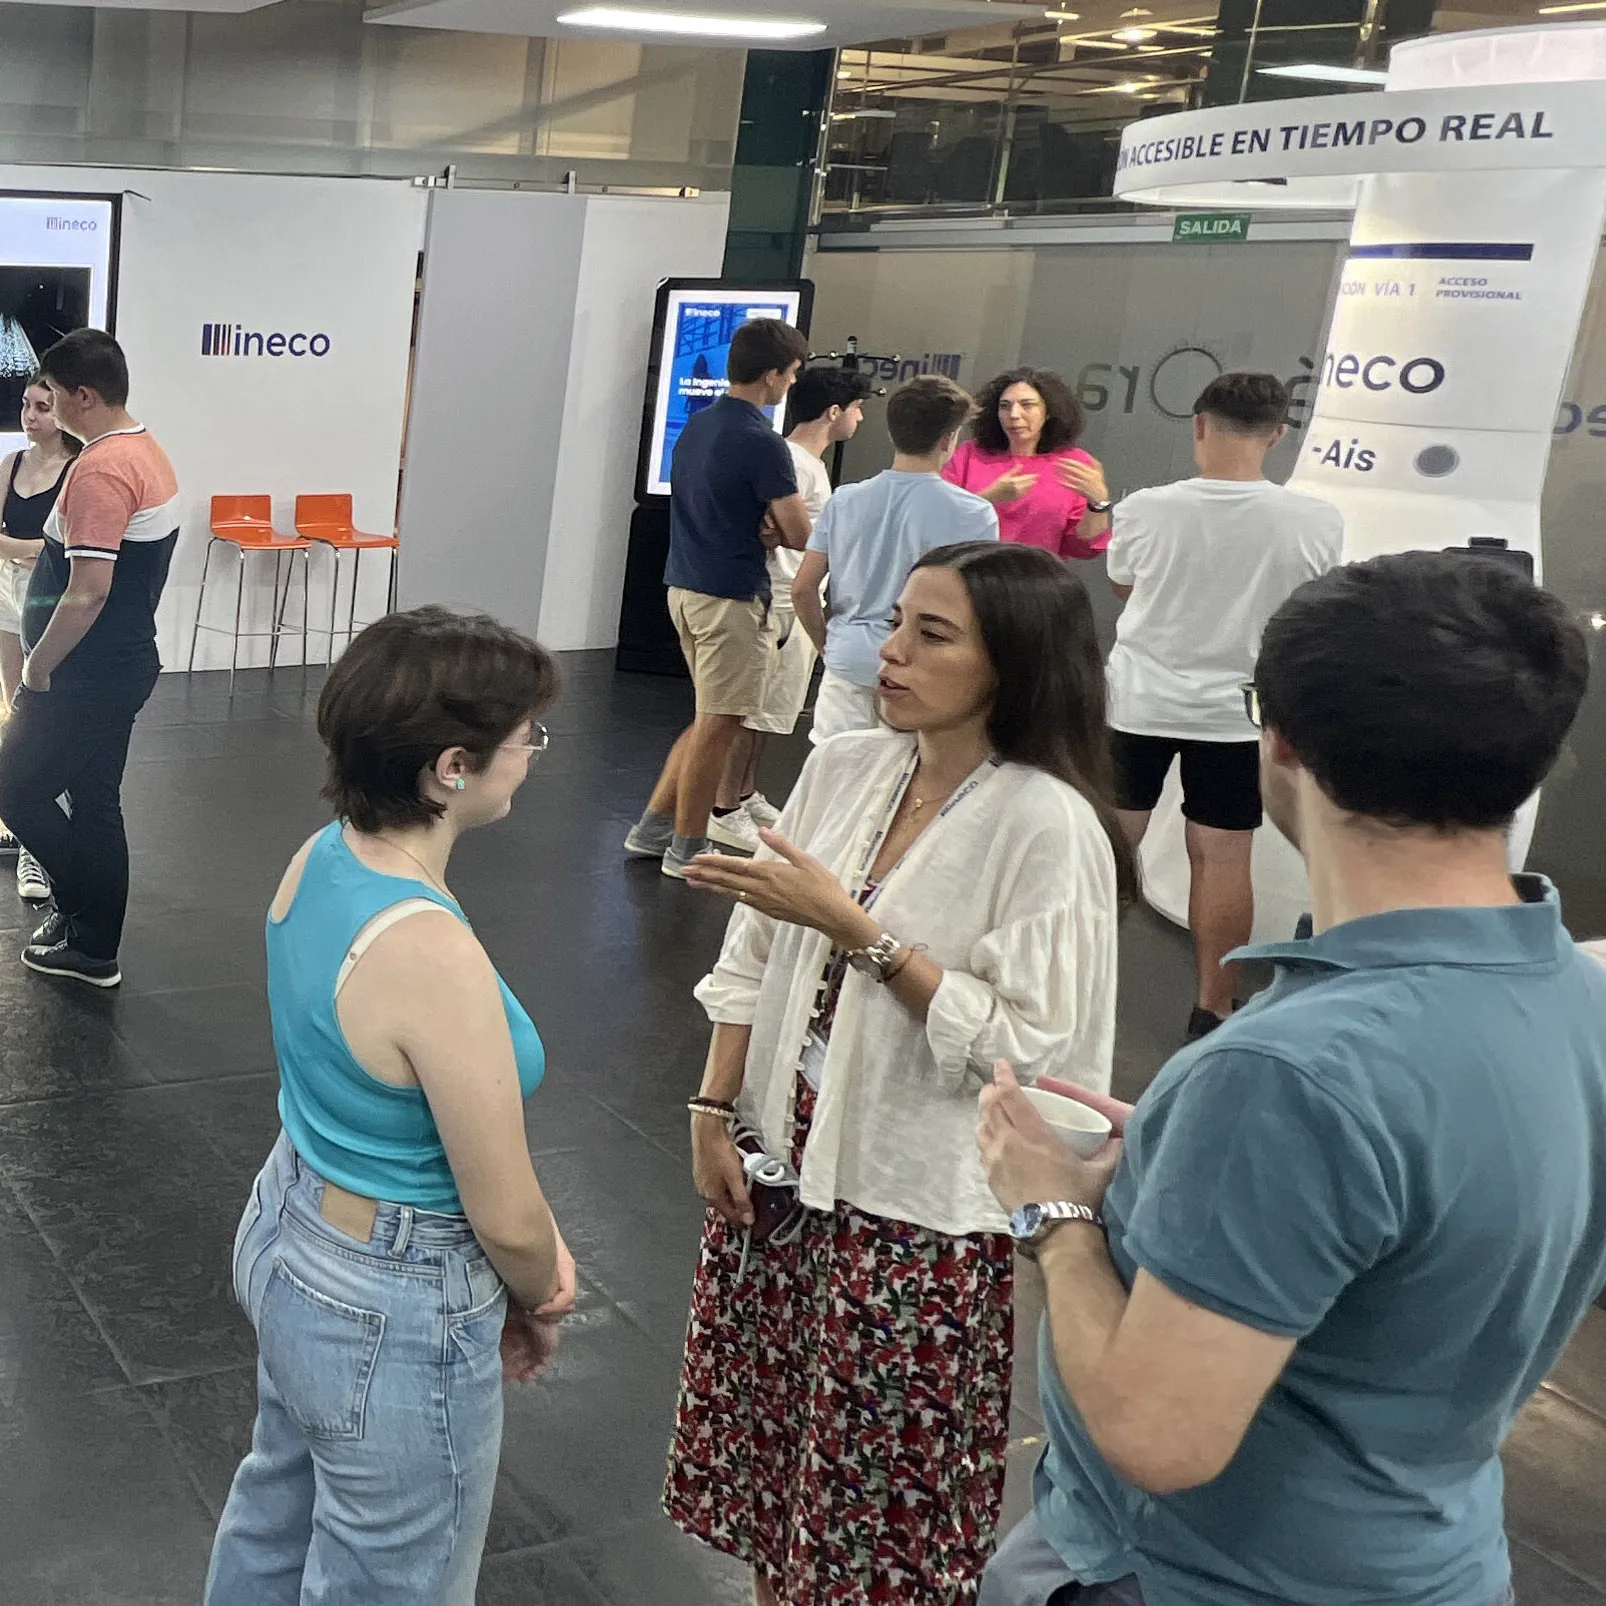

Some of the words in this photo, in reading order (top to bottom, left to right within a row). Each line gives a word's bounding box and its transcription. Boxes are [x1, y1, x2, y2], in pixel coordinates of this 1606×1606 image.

[1130, 132, 1225, 169] ACCESIBLE
[1231, 127, 1271, 155] EN
[1280, 116, 1427, 150] TIEMPO
[1438, 111, 1554, 142] REAL
[58, 216, 97, 231] ineco
[1179, 219, 1242, 235] SALIDA
[1374, 279, 1400, 296] VÍA
[1408, 283, 1416, 296] 1
[1438, 277, 1488, 287] ACCESO
[1435, 289, 1522, 300] PROVISIONAL
[234, 323, 331, 357] ineco
